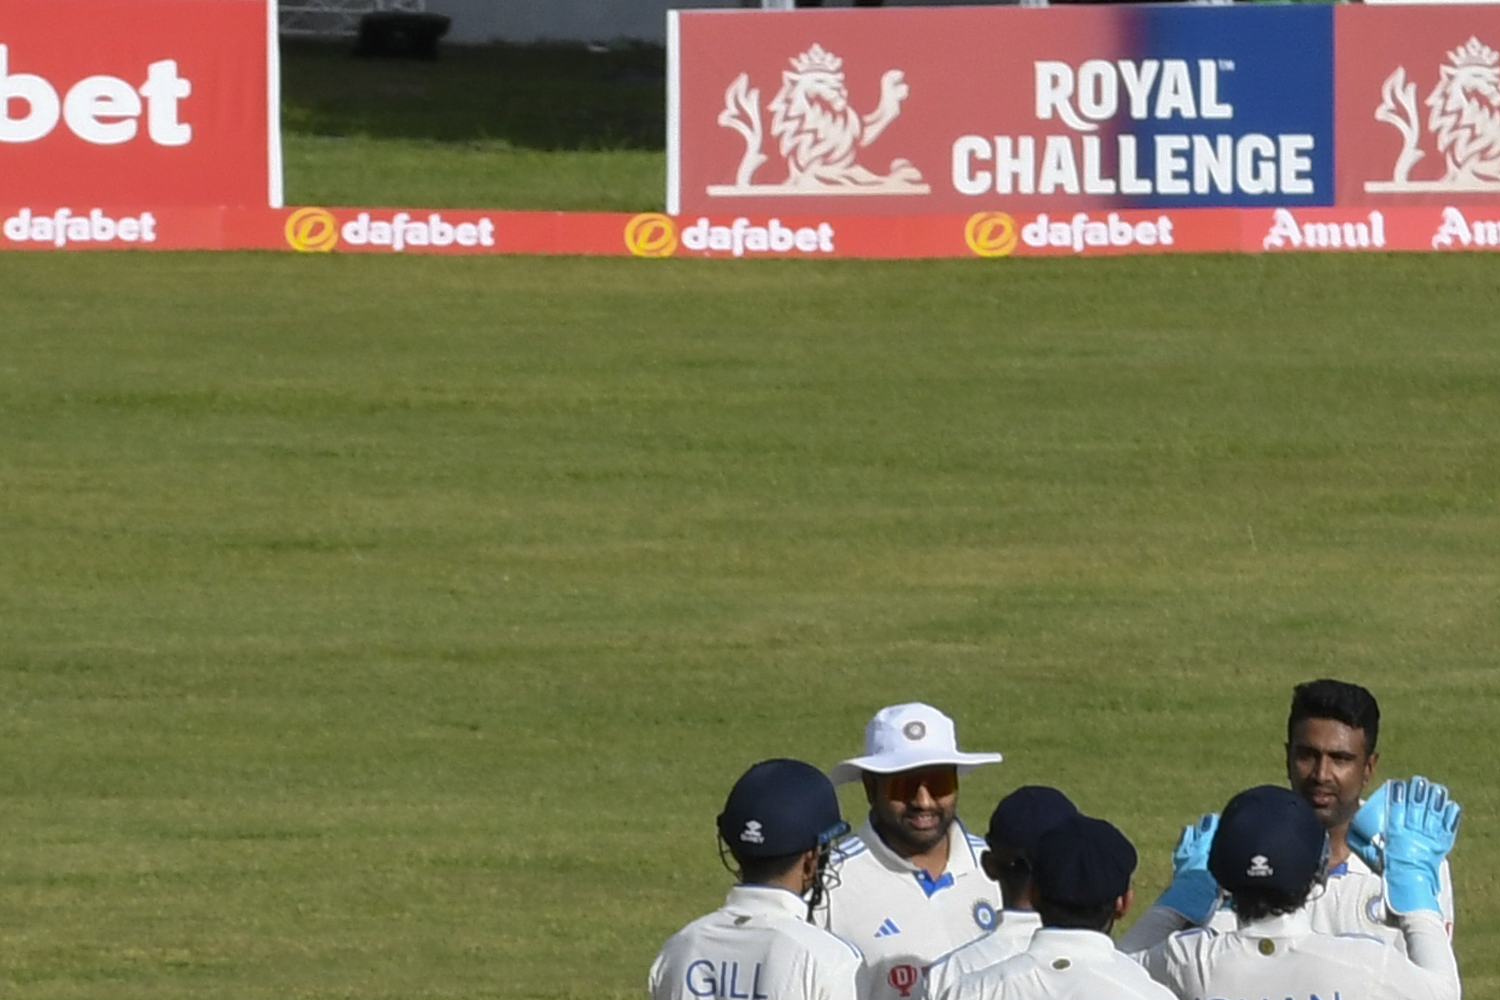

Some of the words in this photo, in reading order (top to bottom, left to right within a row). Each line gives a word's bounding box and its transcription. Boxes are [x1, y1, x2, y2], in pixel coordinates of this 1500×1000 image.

[1034, 59, 1233, 131] ROYAL
[951, 133, 1315, 196] CHALLENGE
[2, 208, 157, 247] dafabet
[341, 212, 495, 251] dafabet
[681, 217, 835, 256] dafabet
[1021, 213, 1174, 256] dafabet
[1262, 208, 1387, 250] Amul
[685, 959, 769, 1000] GILL
